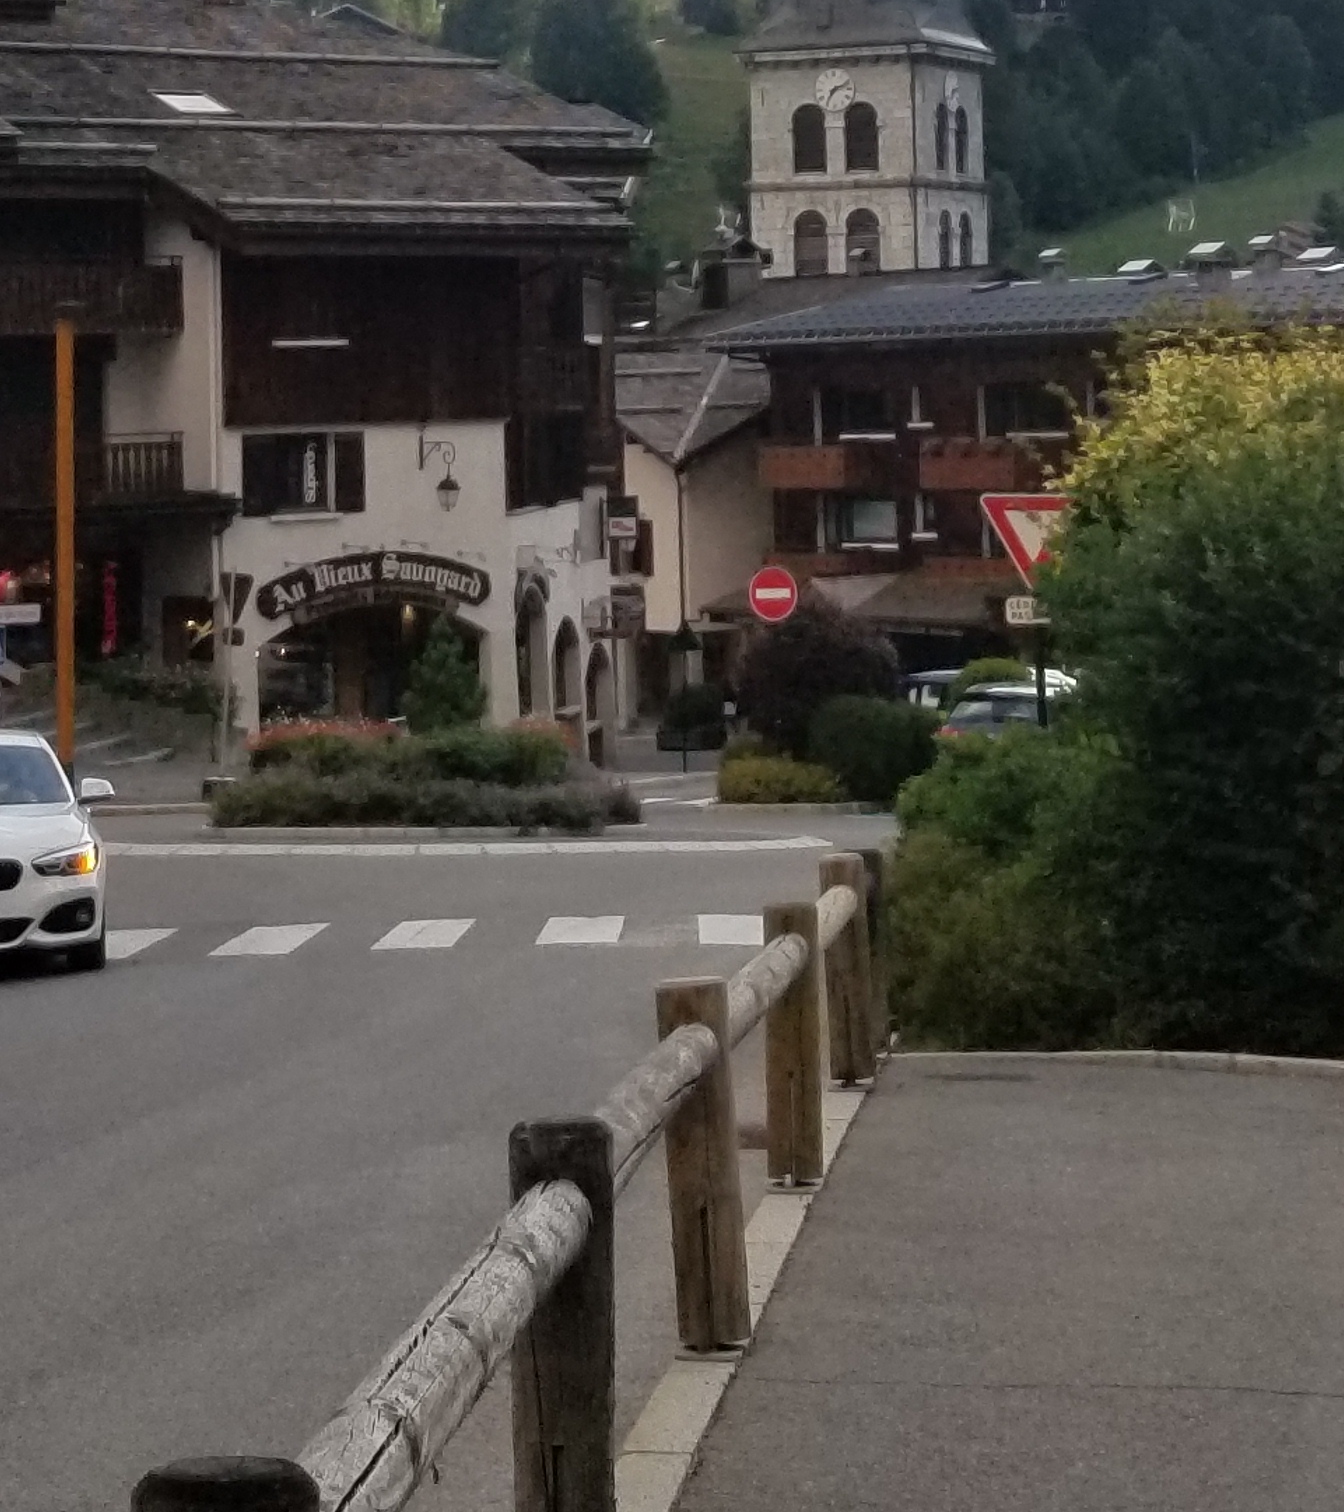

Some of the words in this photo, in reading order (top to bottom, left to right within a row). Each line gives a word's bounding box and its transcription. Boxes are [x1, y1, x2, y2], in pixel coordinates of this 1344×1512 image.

[273, 581, 307, 613] Au
[313, 560, 373, 592] Vieux
[381, 552, 482, 599] Savoyard
